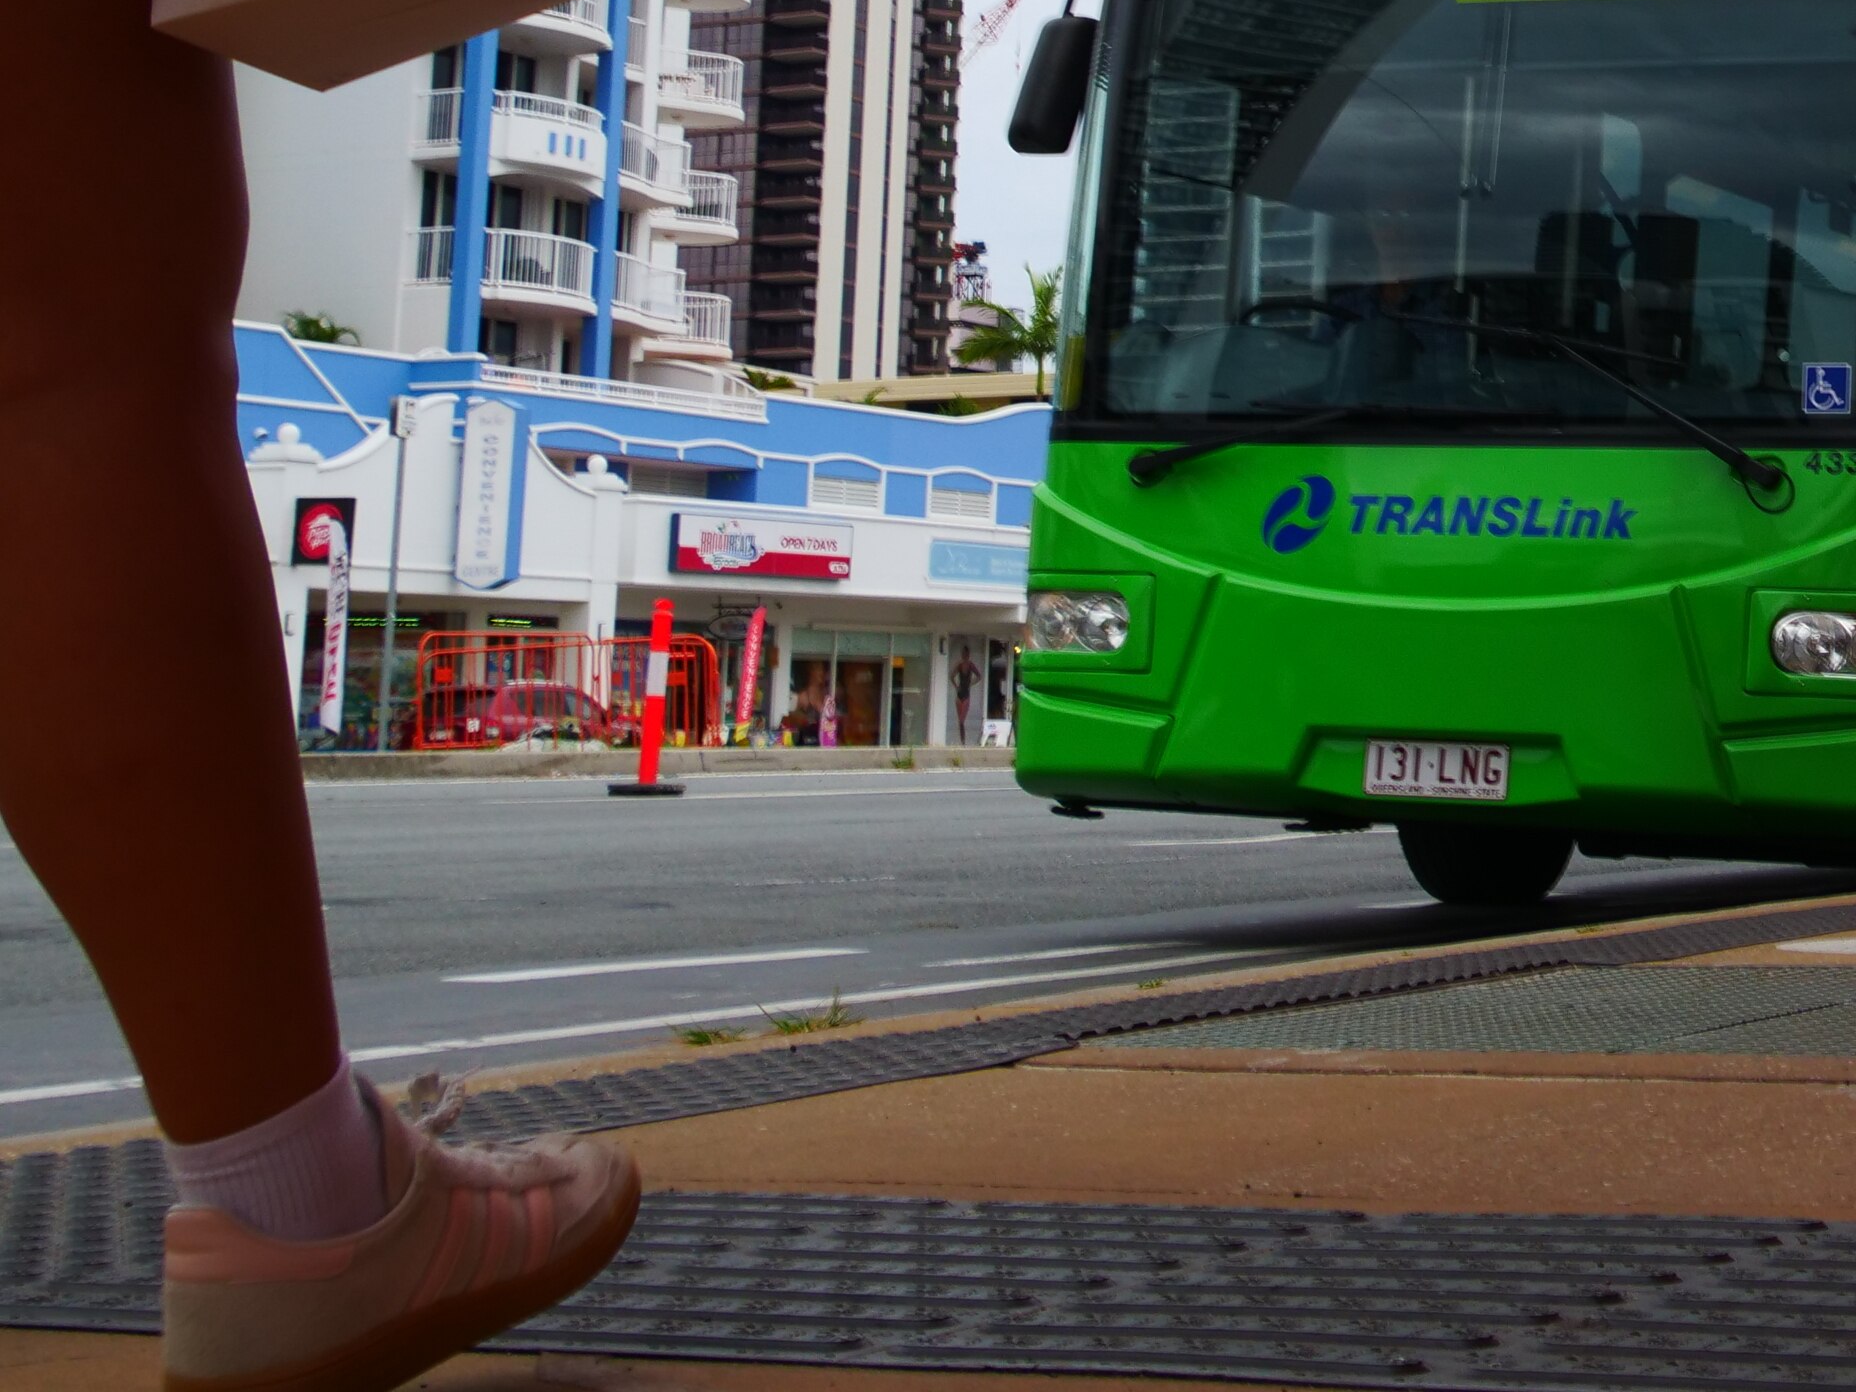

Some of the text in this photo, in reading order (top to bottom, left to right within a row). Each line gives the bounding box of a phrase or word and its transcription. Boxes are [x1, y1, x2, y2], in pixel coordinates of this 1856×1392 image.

[1348, 493, 1640, 540] TRANSLink
[780, 536, 806, 551] OPEN
[813, 538, 839, 553] DAYS
